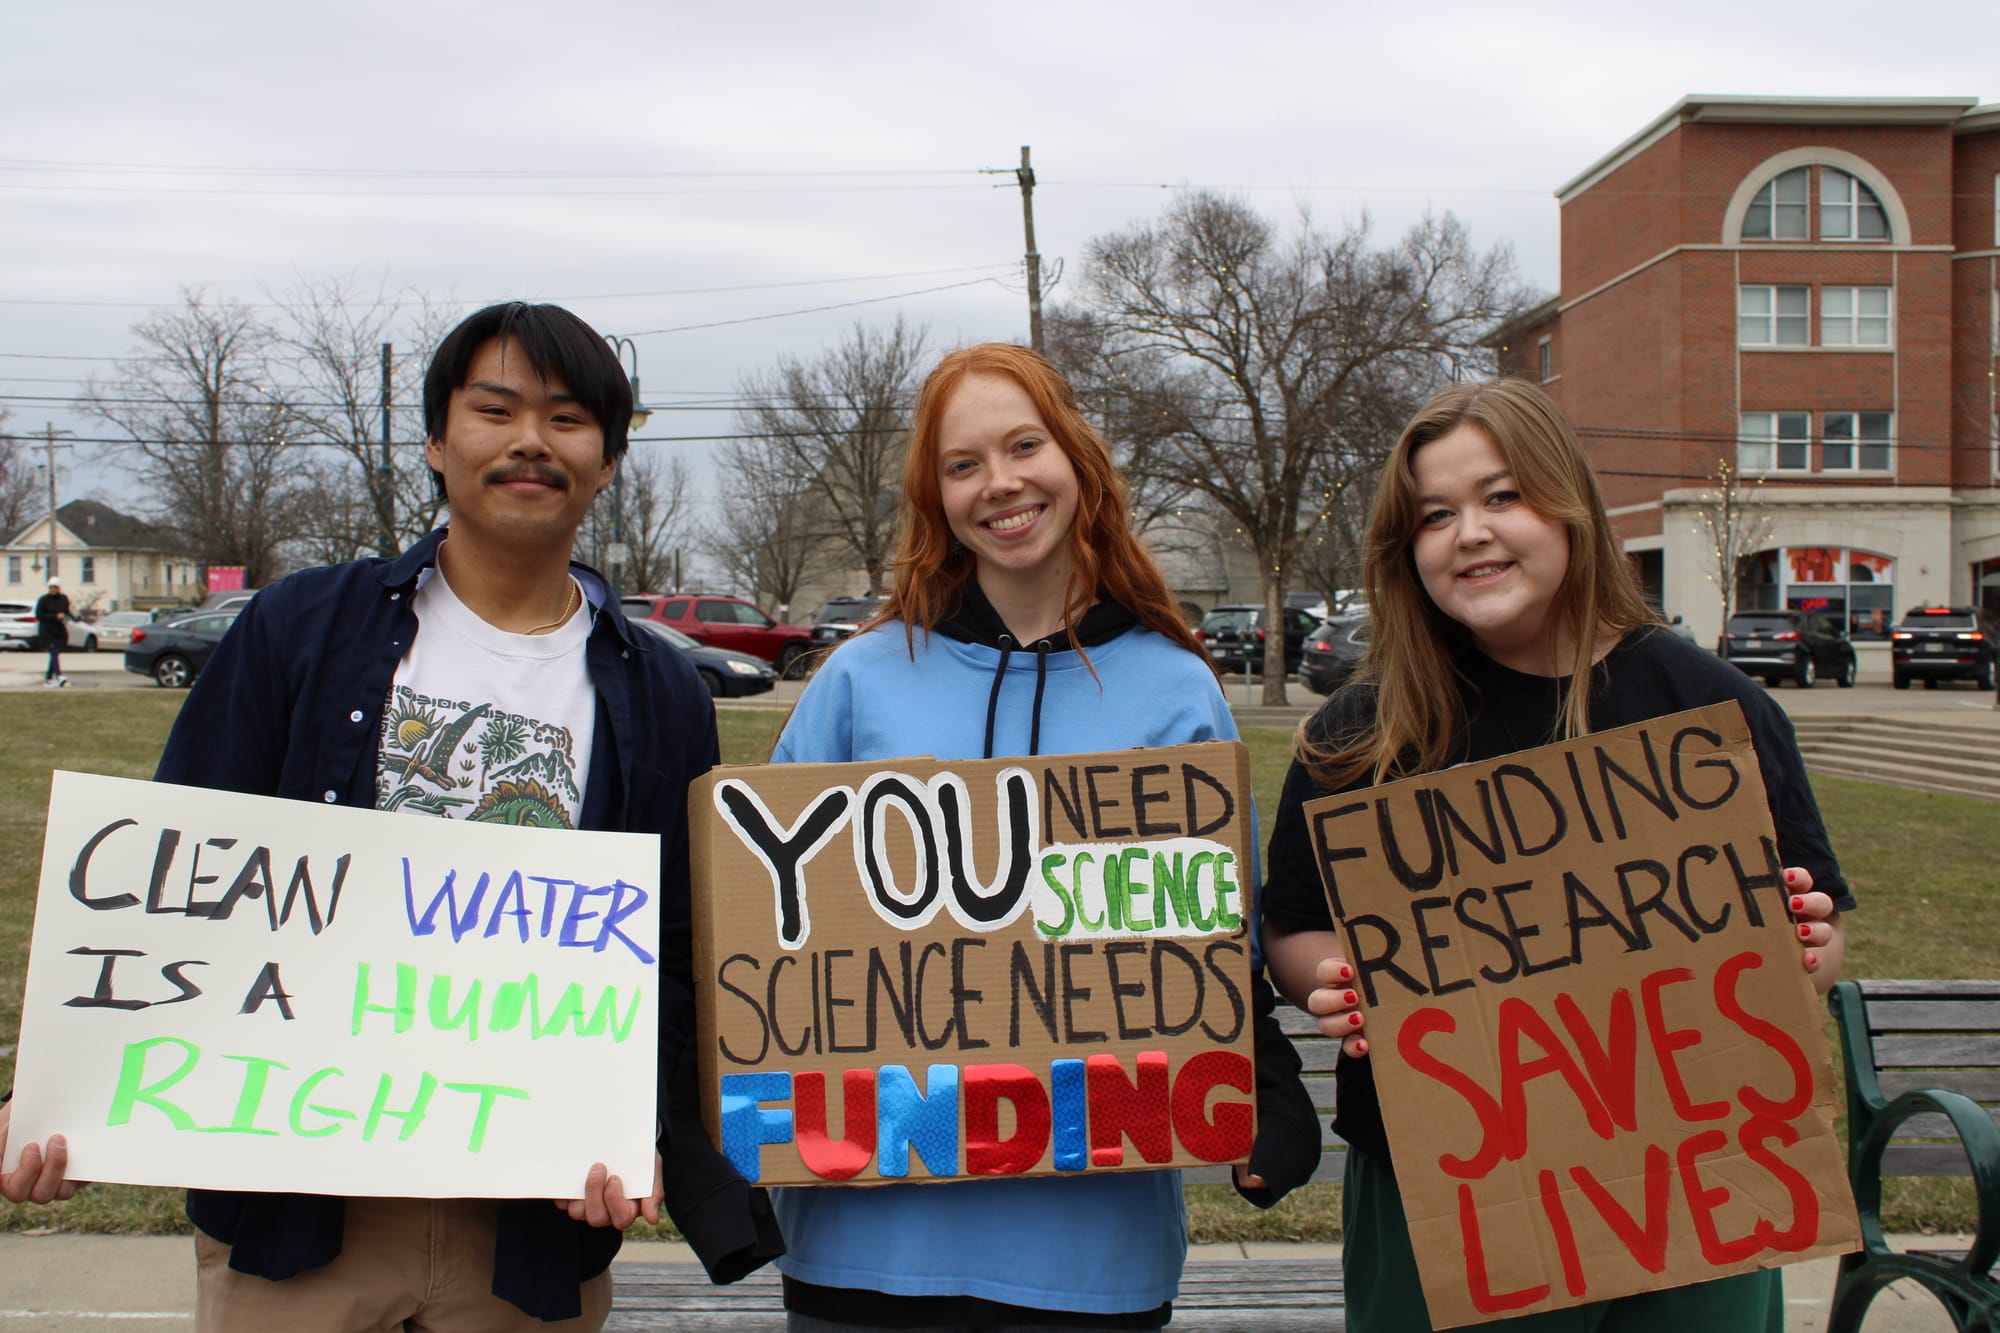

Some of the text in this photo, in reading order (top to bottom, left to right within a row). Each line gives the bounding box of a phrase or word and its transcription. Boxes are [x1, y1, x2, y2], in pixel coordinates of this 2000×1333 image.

[69, 818, 656, 964] CLEAN WATER
[714, 763, 1236, 950] YOU NEED
[1313, 725, 1741, 918] FUNDING
[62, 946, 642, 1043] IS A HUMAN
[717, 937, 1246, 1065] SCIENCE NEEDS
[1342, 835, 1796, 1008] RESEARCH
[106, 1036, 532, 1153] RIGHT
[720, 1050, 1253, 1184] FUNDING
[1397, 951, 1813, 1179] SAVES
[1458, 1117, 1819, 1314] LIVES
